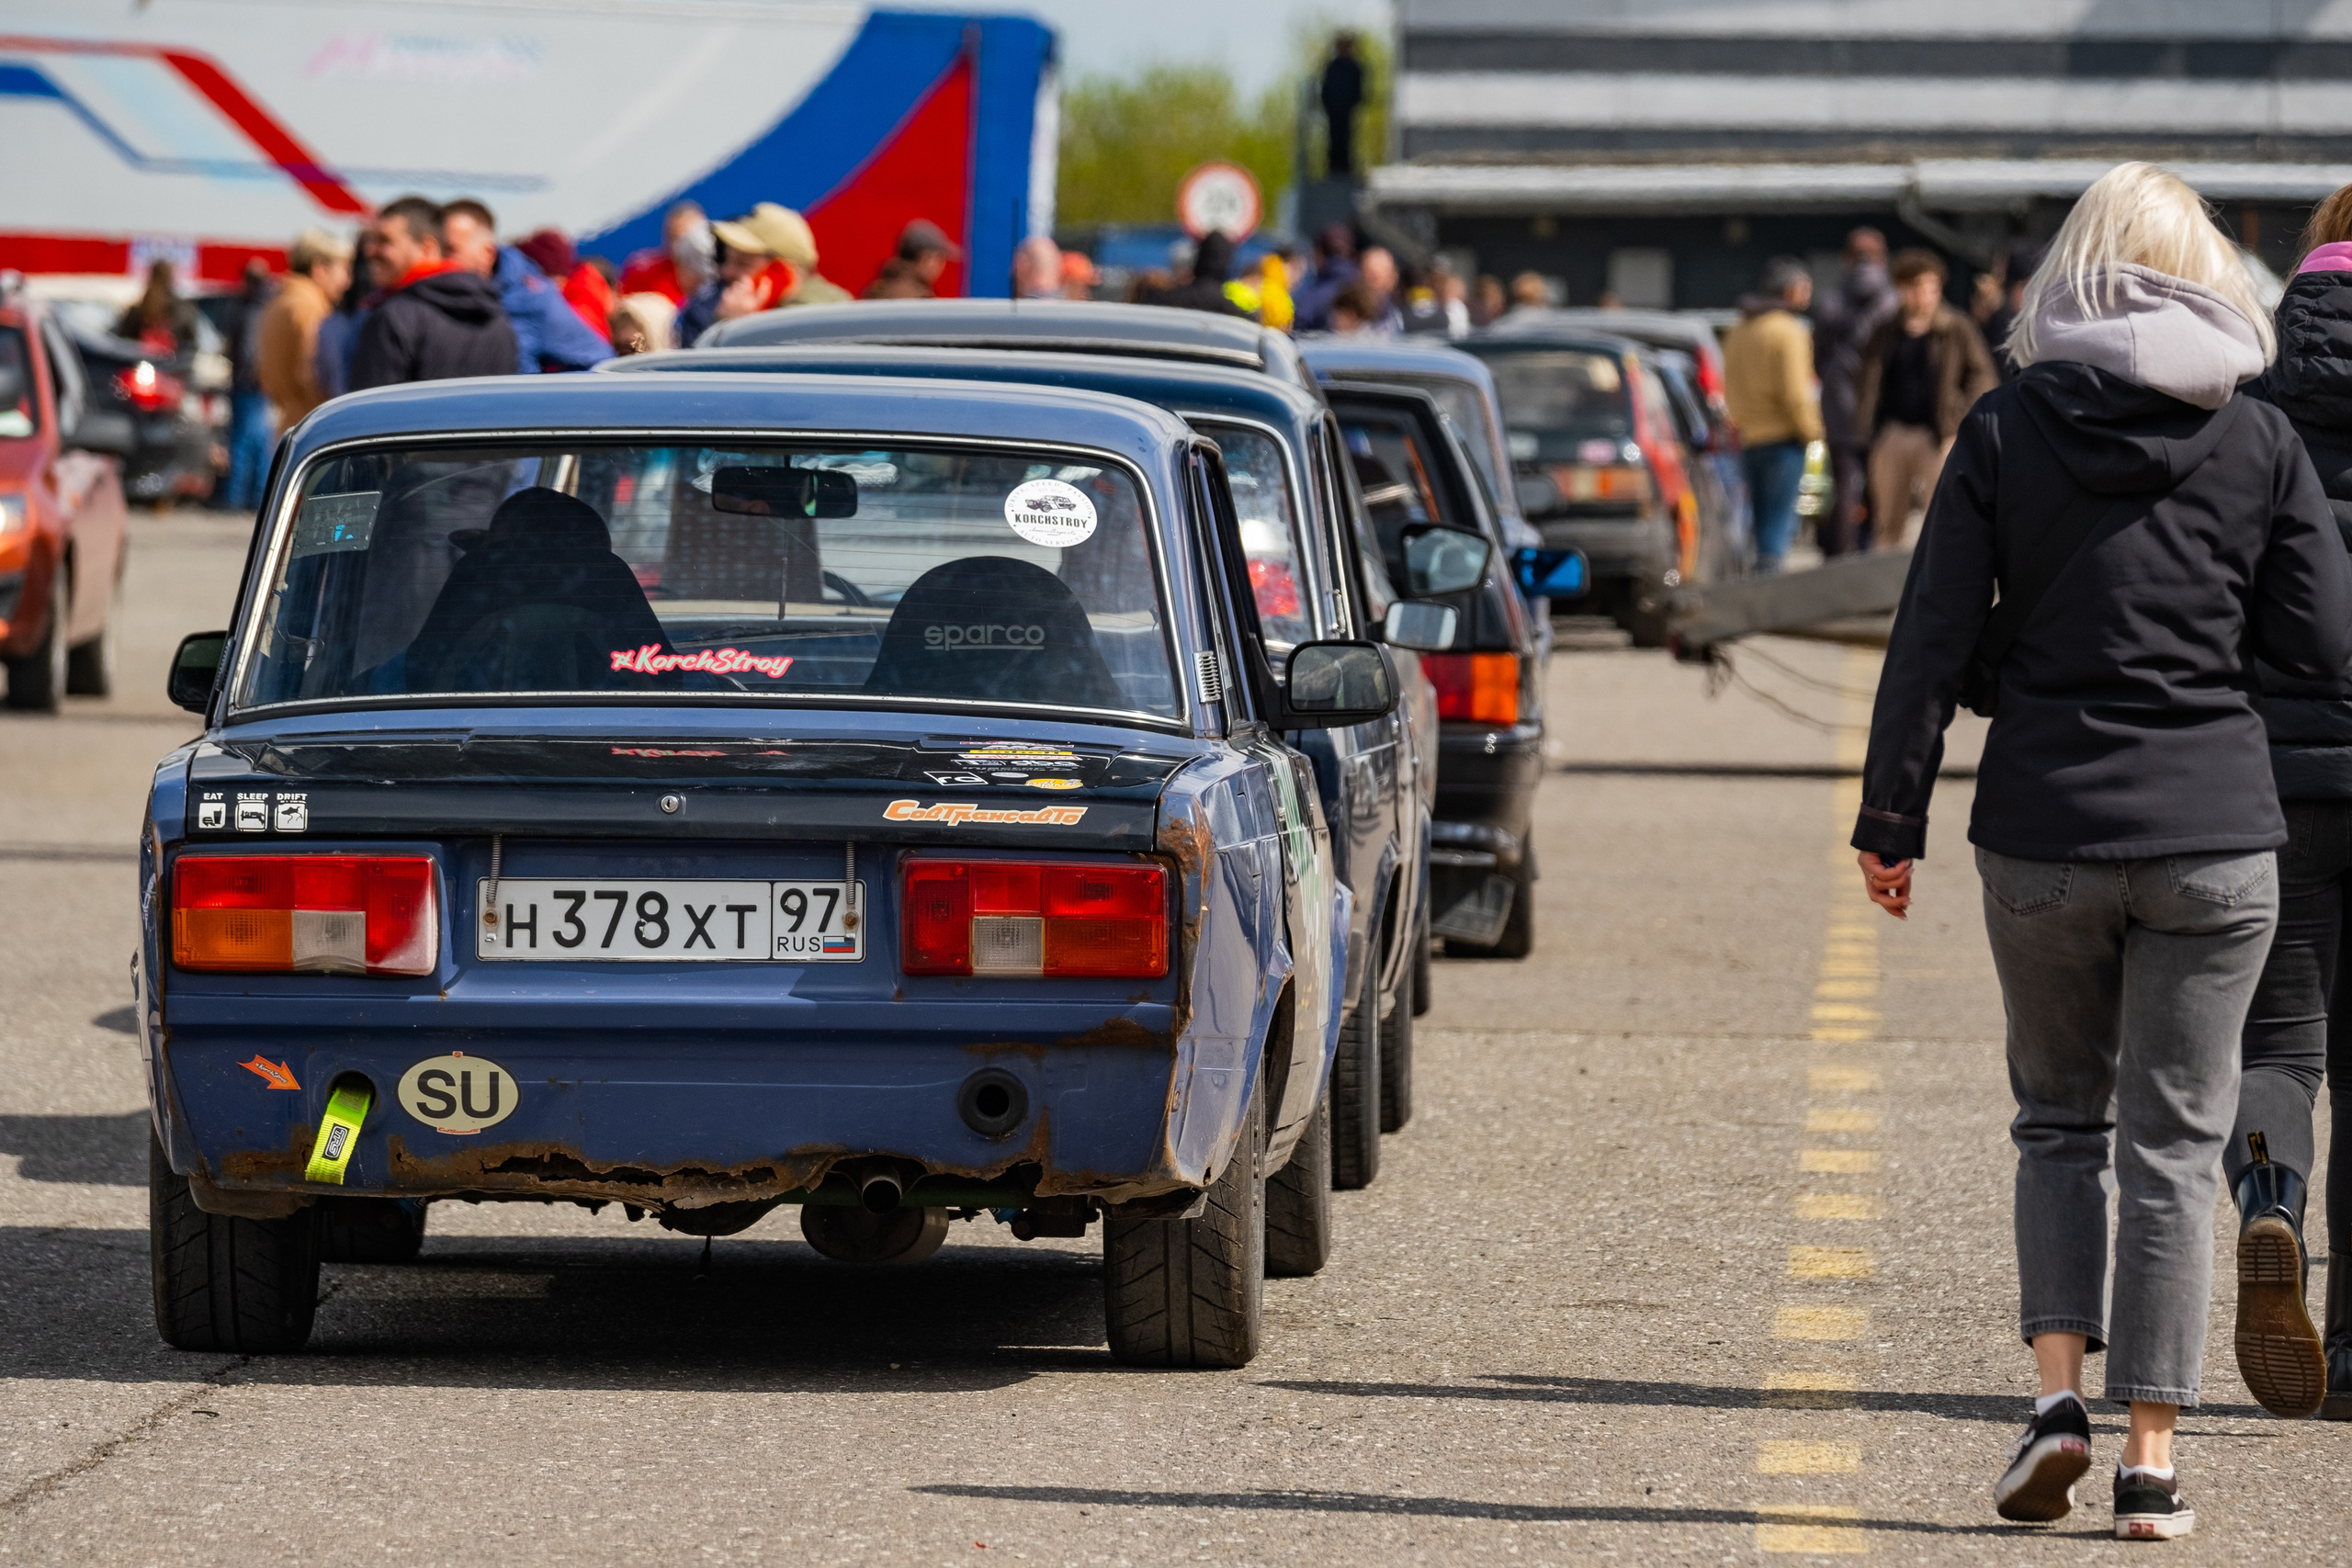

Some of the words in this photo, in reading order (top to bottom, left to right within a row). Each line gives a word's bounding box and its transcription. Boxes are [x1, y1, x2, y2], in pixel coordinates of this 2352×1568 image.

[1014, 513, 1088, 528] KORCHSTROY
[1019, 530, 1041, 542] AUTO
[924, 625, 1046, 650] sparco
[779, 887, 840, 933] 97
[776, 936, 820, 952] RUS
[416, 1069, 500, 1119] SU
